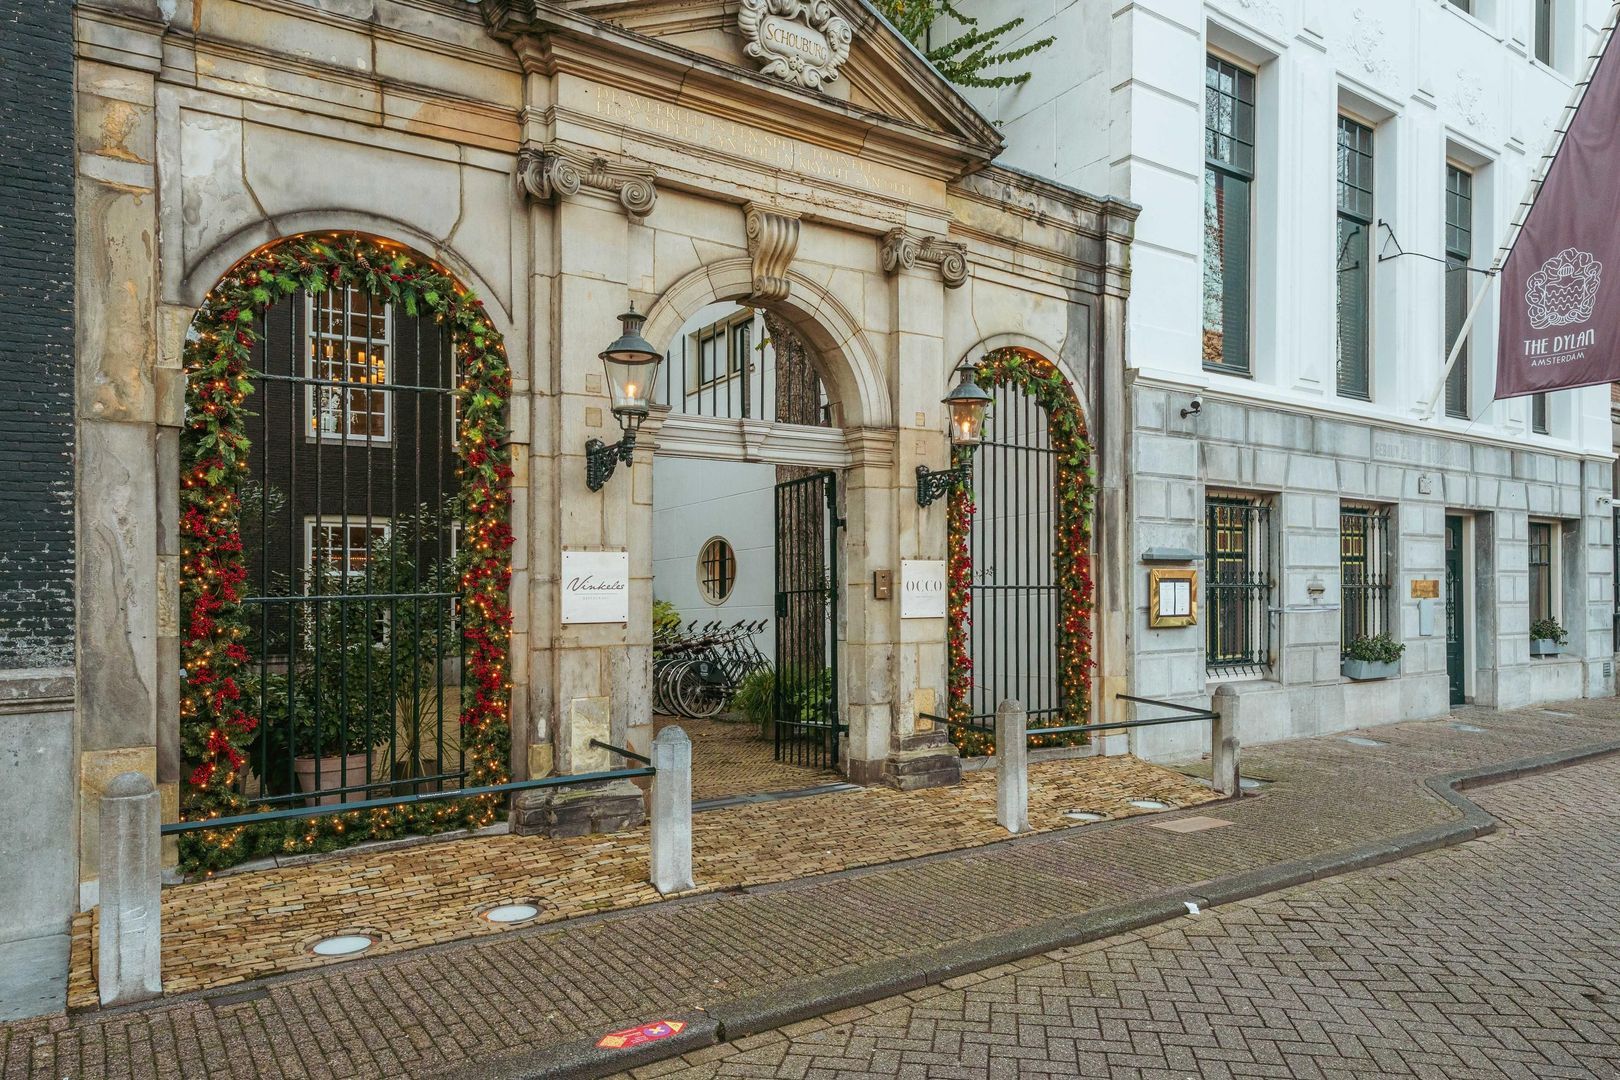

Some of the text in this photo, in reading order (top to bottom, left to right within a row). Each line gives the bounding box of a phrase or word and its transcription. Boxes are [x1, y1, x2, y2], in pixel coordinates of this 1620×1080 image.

[766, 23, 827, 61] SCHOUBURG
[1524, 328, 1595, 356] THE DYLAN
[1531, 352, 1585, 367] AMSTERDAM
[567, 575, 625, 592] Vinkeles
[906, 579, 942, 592] OCCO
